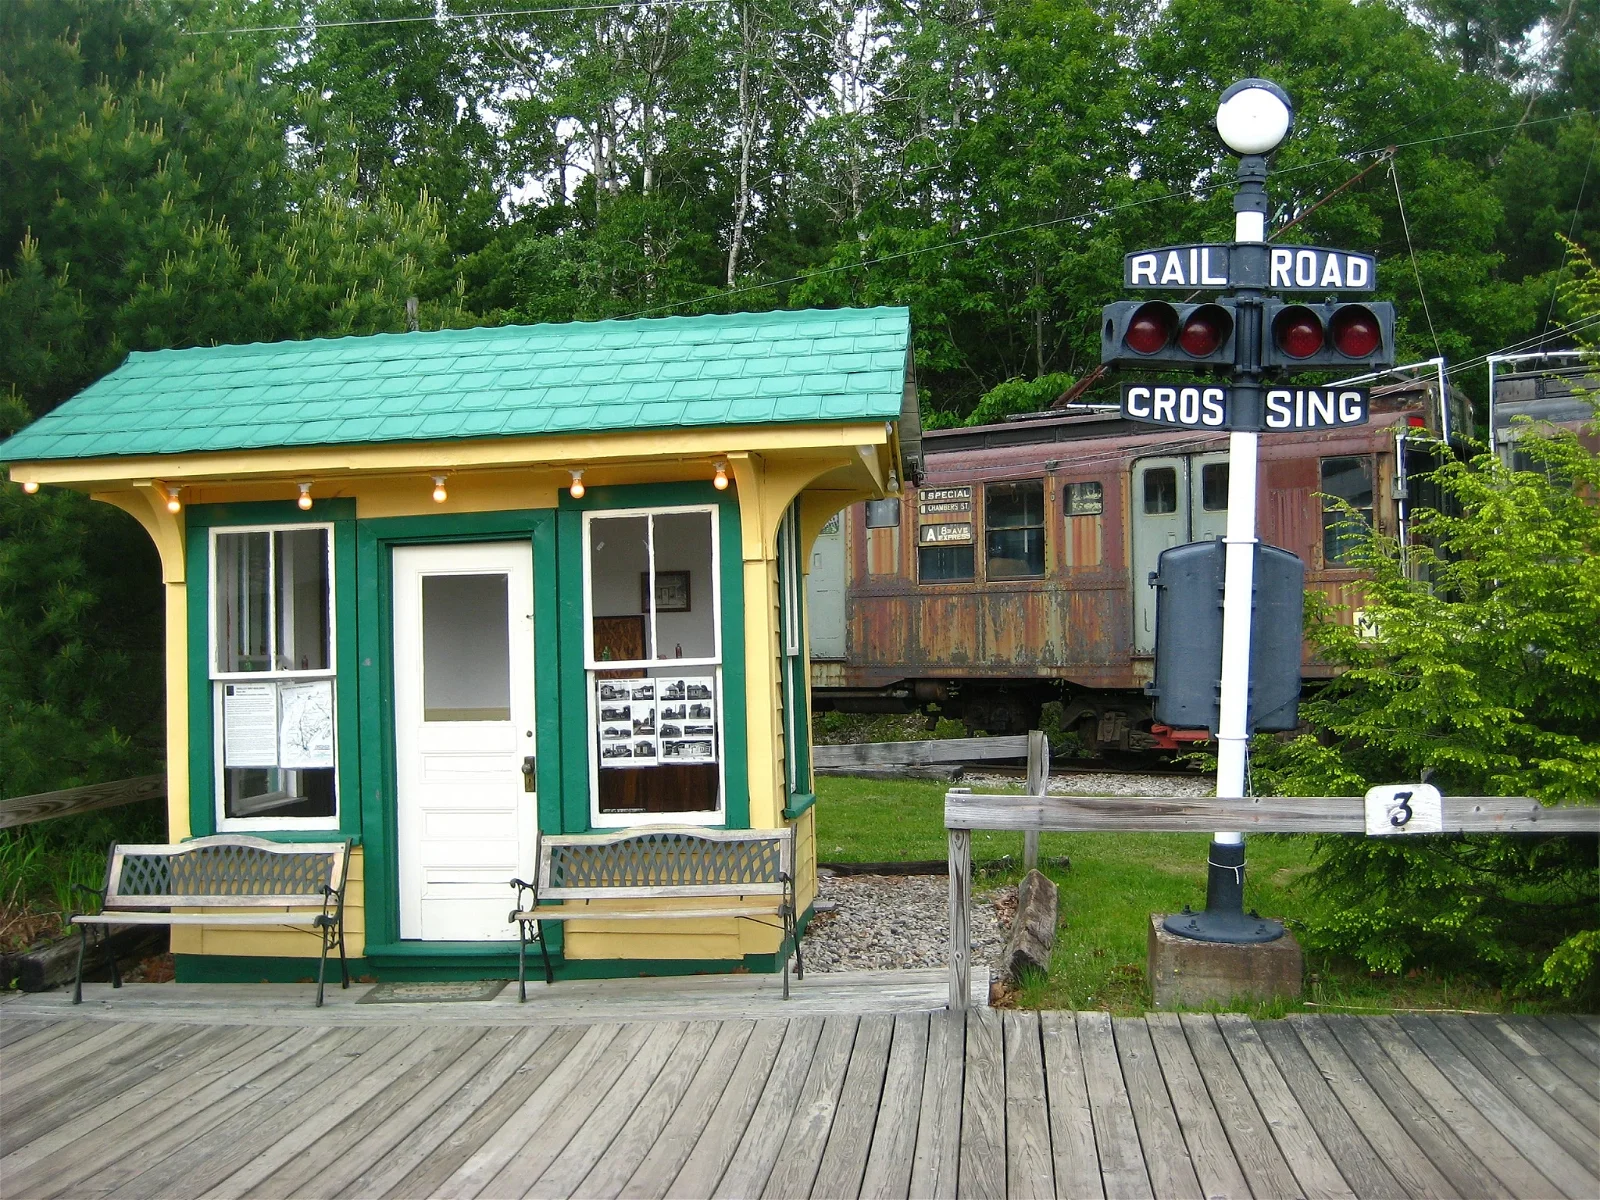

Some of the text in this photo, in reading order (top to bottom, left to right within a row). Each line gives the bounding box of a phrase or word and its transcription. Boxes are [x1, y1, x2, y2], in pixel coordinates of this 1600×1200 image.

[1131, 247, 1368, 287] RAIL ROAD
[1127, 387, 1362, 428] CROS SING
[927, 490, 970, 500] SPECIAL
[927, 502, 958, 512] CHAMBERS
[926, 528, 936, 542] A
[952, 526, 969, 535] AVE
[1390, 791, 1414, 827] 3
